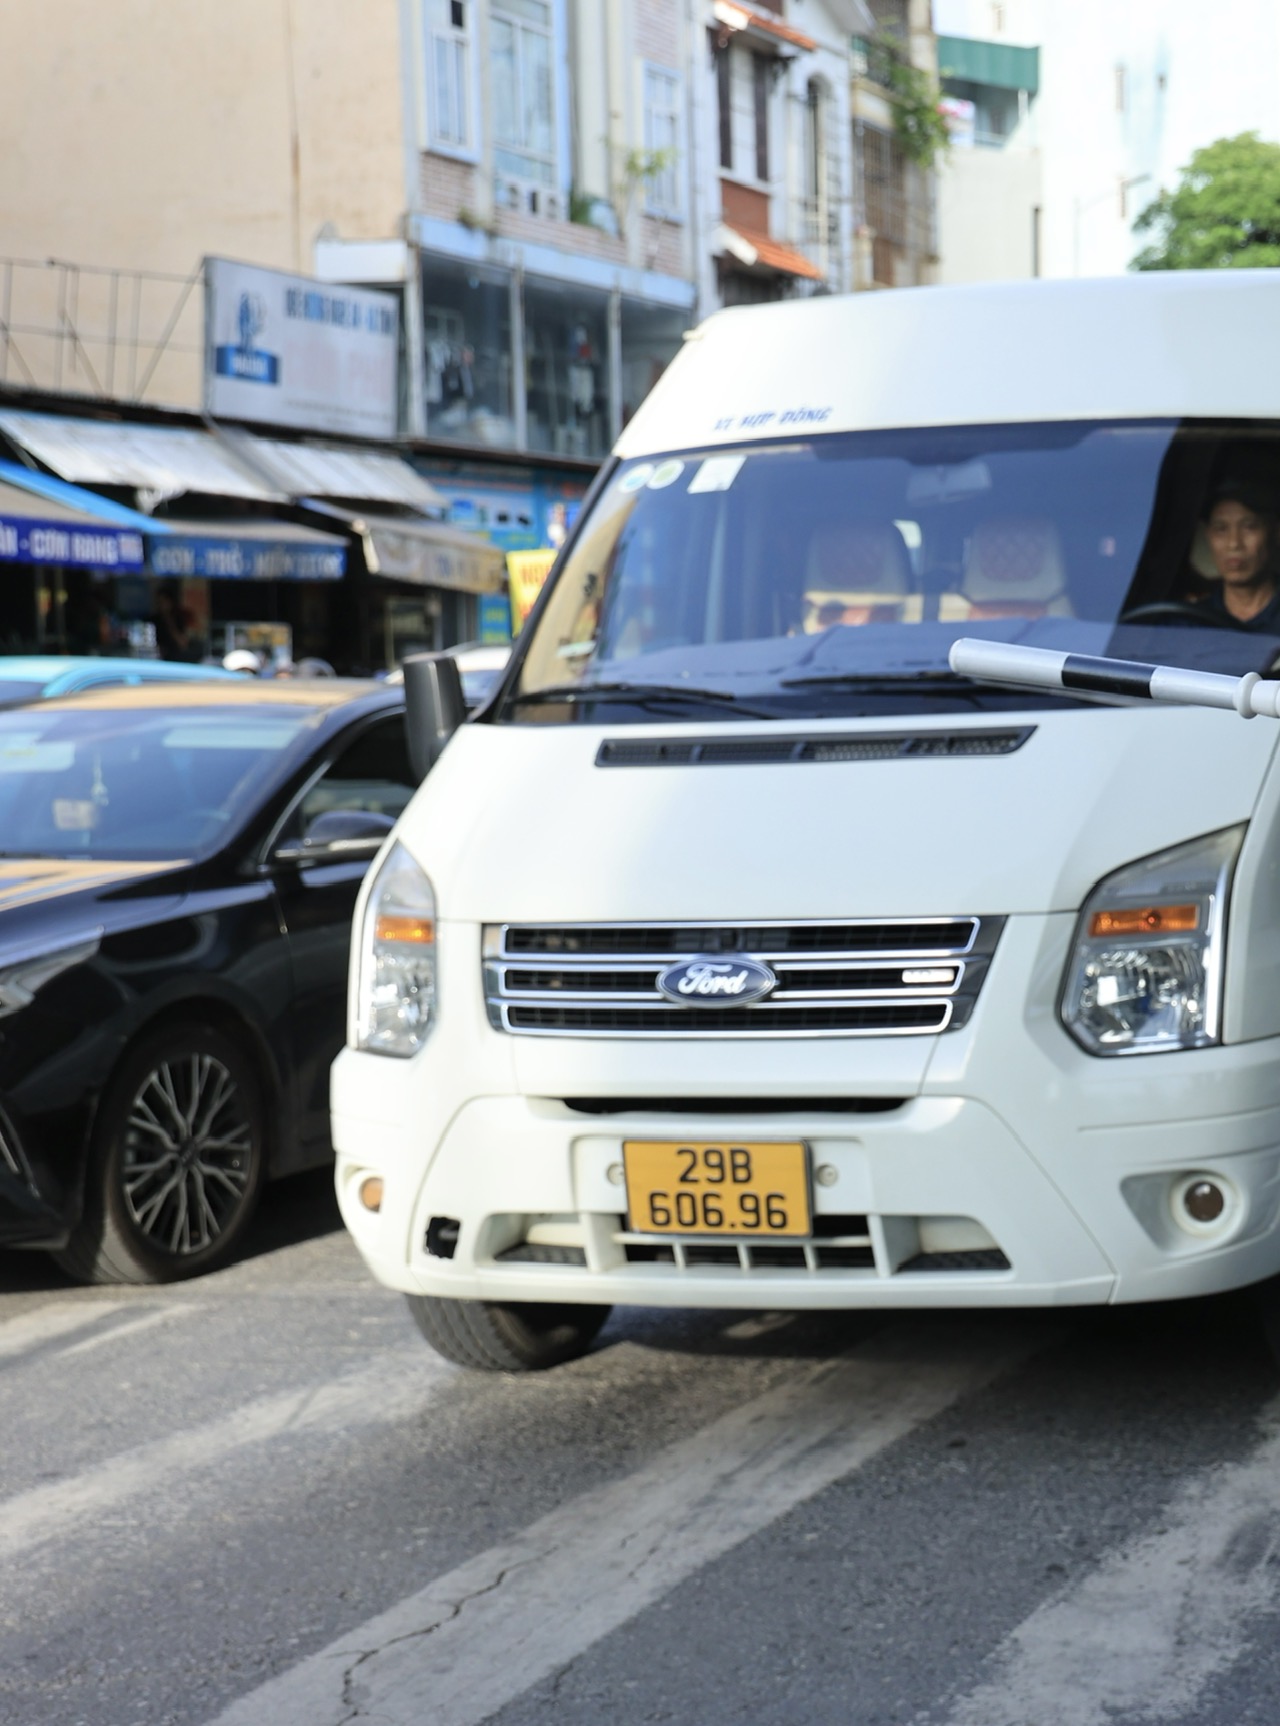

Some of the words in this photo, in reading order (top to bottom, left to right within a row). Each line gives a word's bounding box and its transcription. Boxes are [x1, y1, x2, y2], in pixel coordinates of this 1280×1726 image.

[677, 962, 749, 995] Ford
[676, 1147, 753, 1184] 29B
[649, 1191, 788, 1229] 606.96
